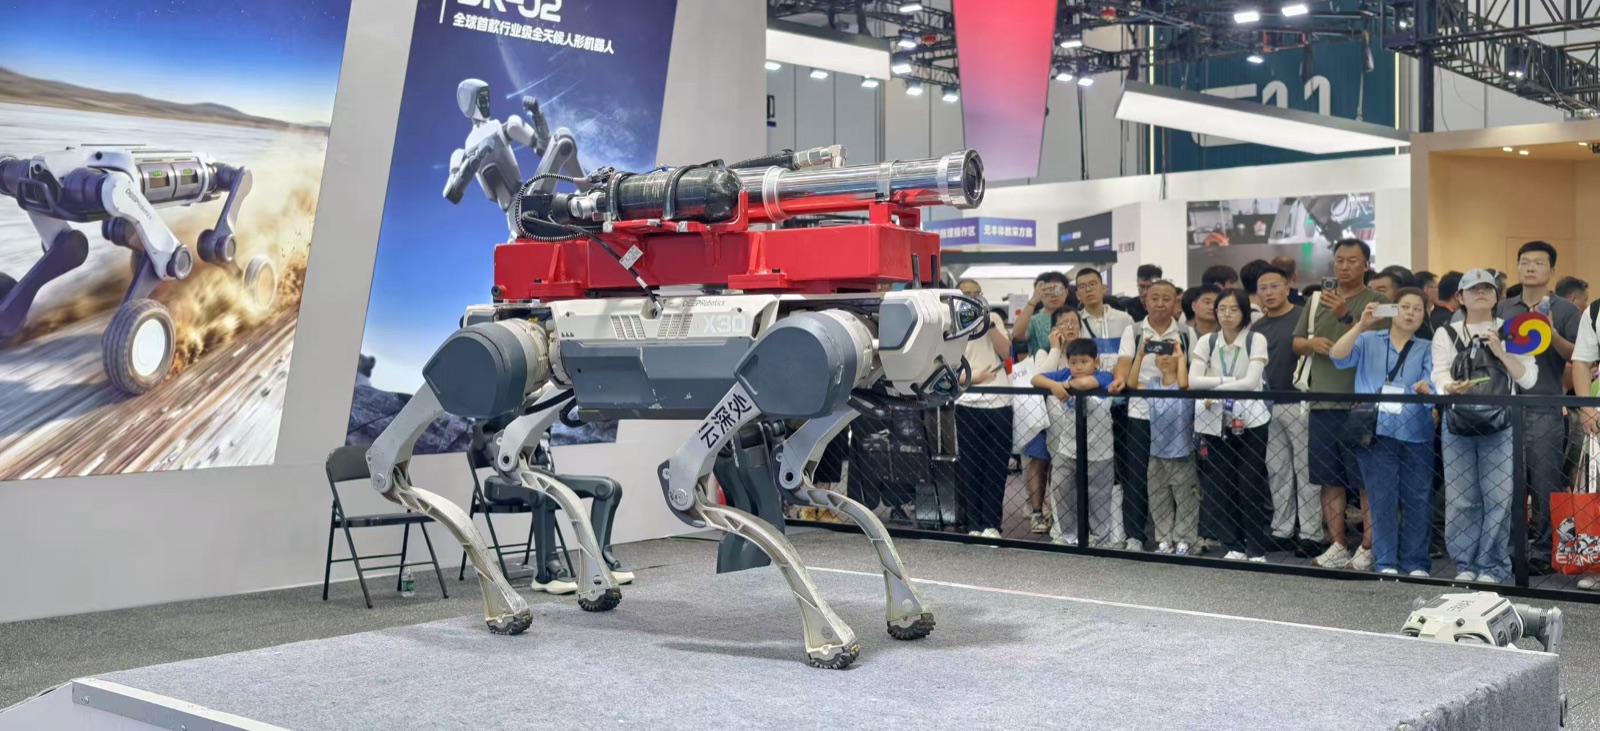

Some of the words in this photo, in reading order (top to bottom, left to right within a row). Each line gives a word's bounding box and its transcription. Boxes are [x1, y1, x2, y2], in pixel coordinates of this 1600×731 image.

[457, 0, 562, 22] -02
[453, 12, 615, 54] 全球首款行业级全天候人形机器人
[703, 314, 747, 333] X30
[699, 393, 752, 448] 云深处
